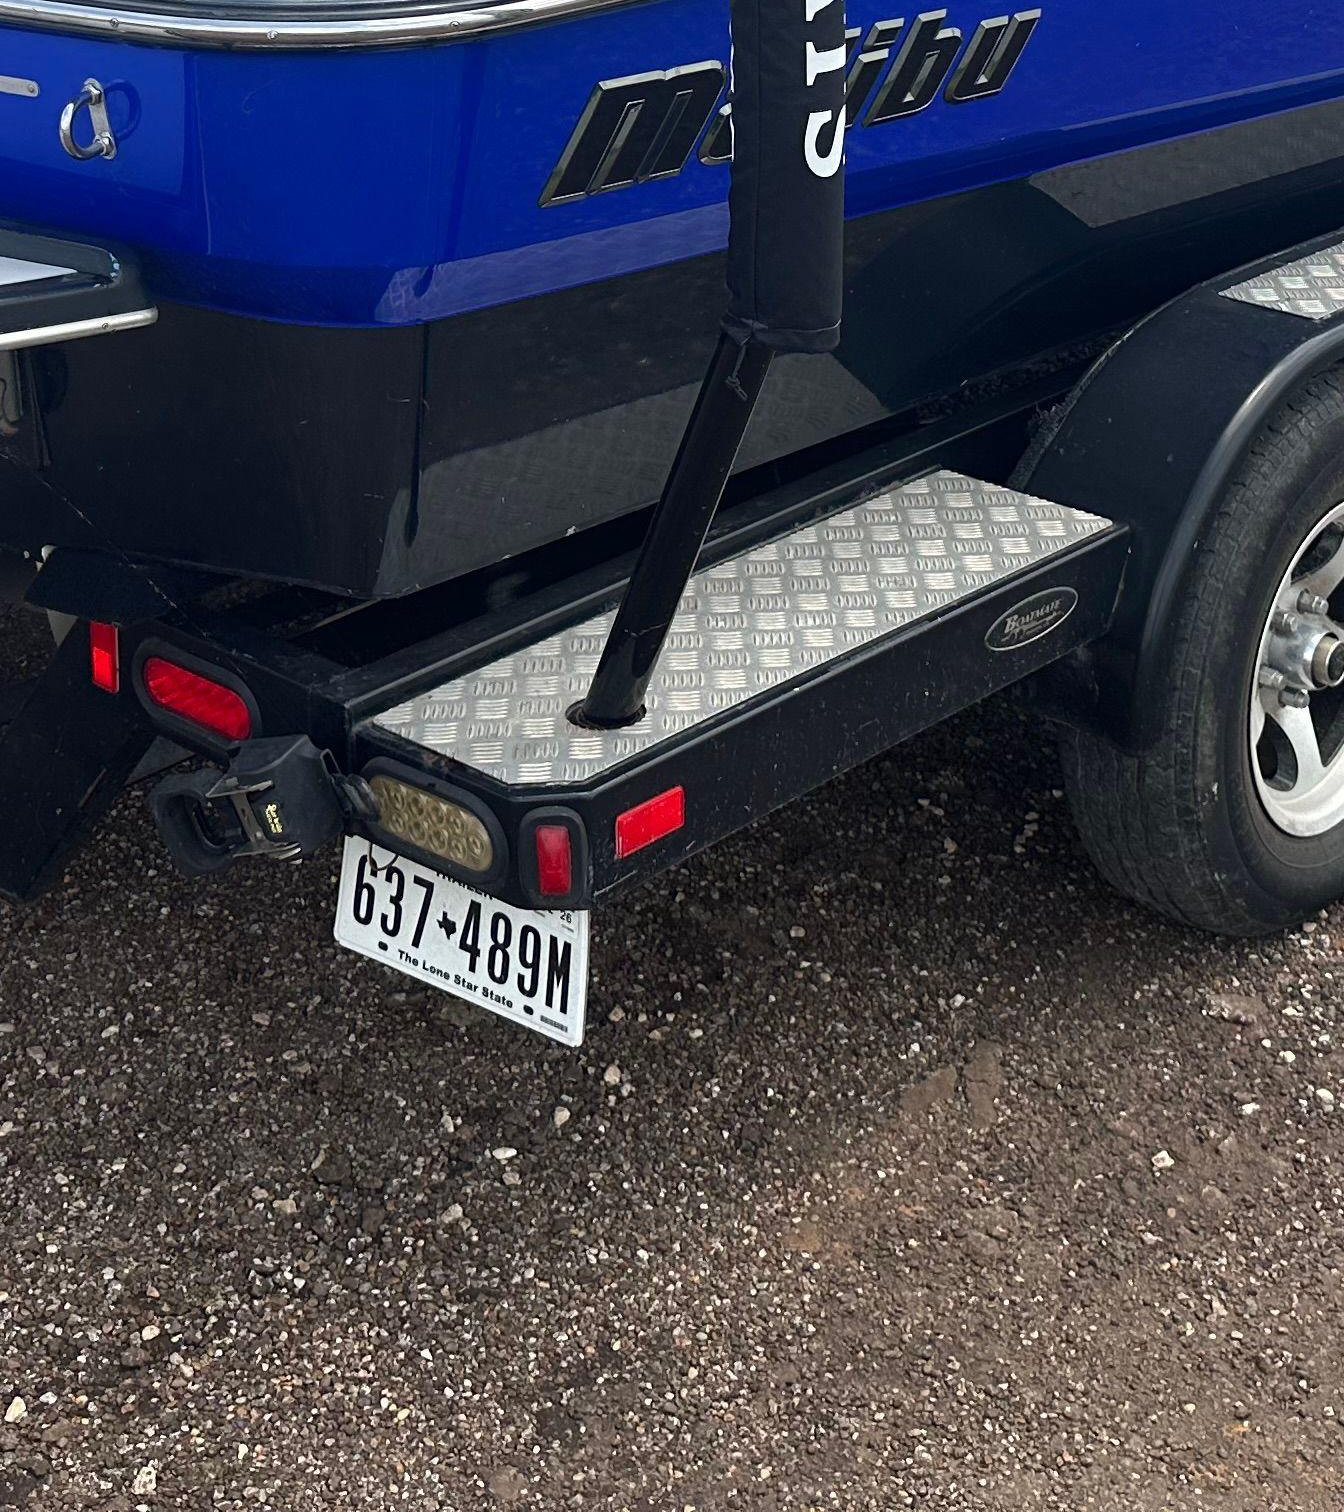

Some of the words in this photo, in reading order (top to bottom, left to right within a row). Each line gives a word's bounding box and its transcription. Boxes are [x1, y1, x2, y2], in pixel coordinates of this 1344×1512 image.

[539, 8, 1042, 208] mibu
[397, 948, 419, 967] The
[422, 959, 450, 980] Lone
[454, 974, 479, 993] Star
[481, 986, 514, 1009] State
